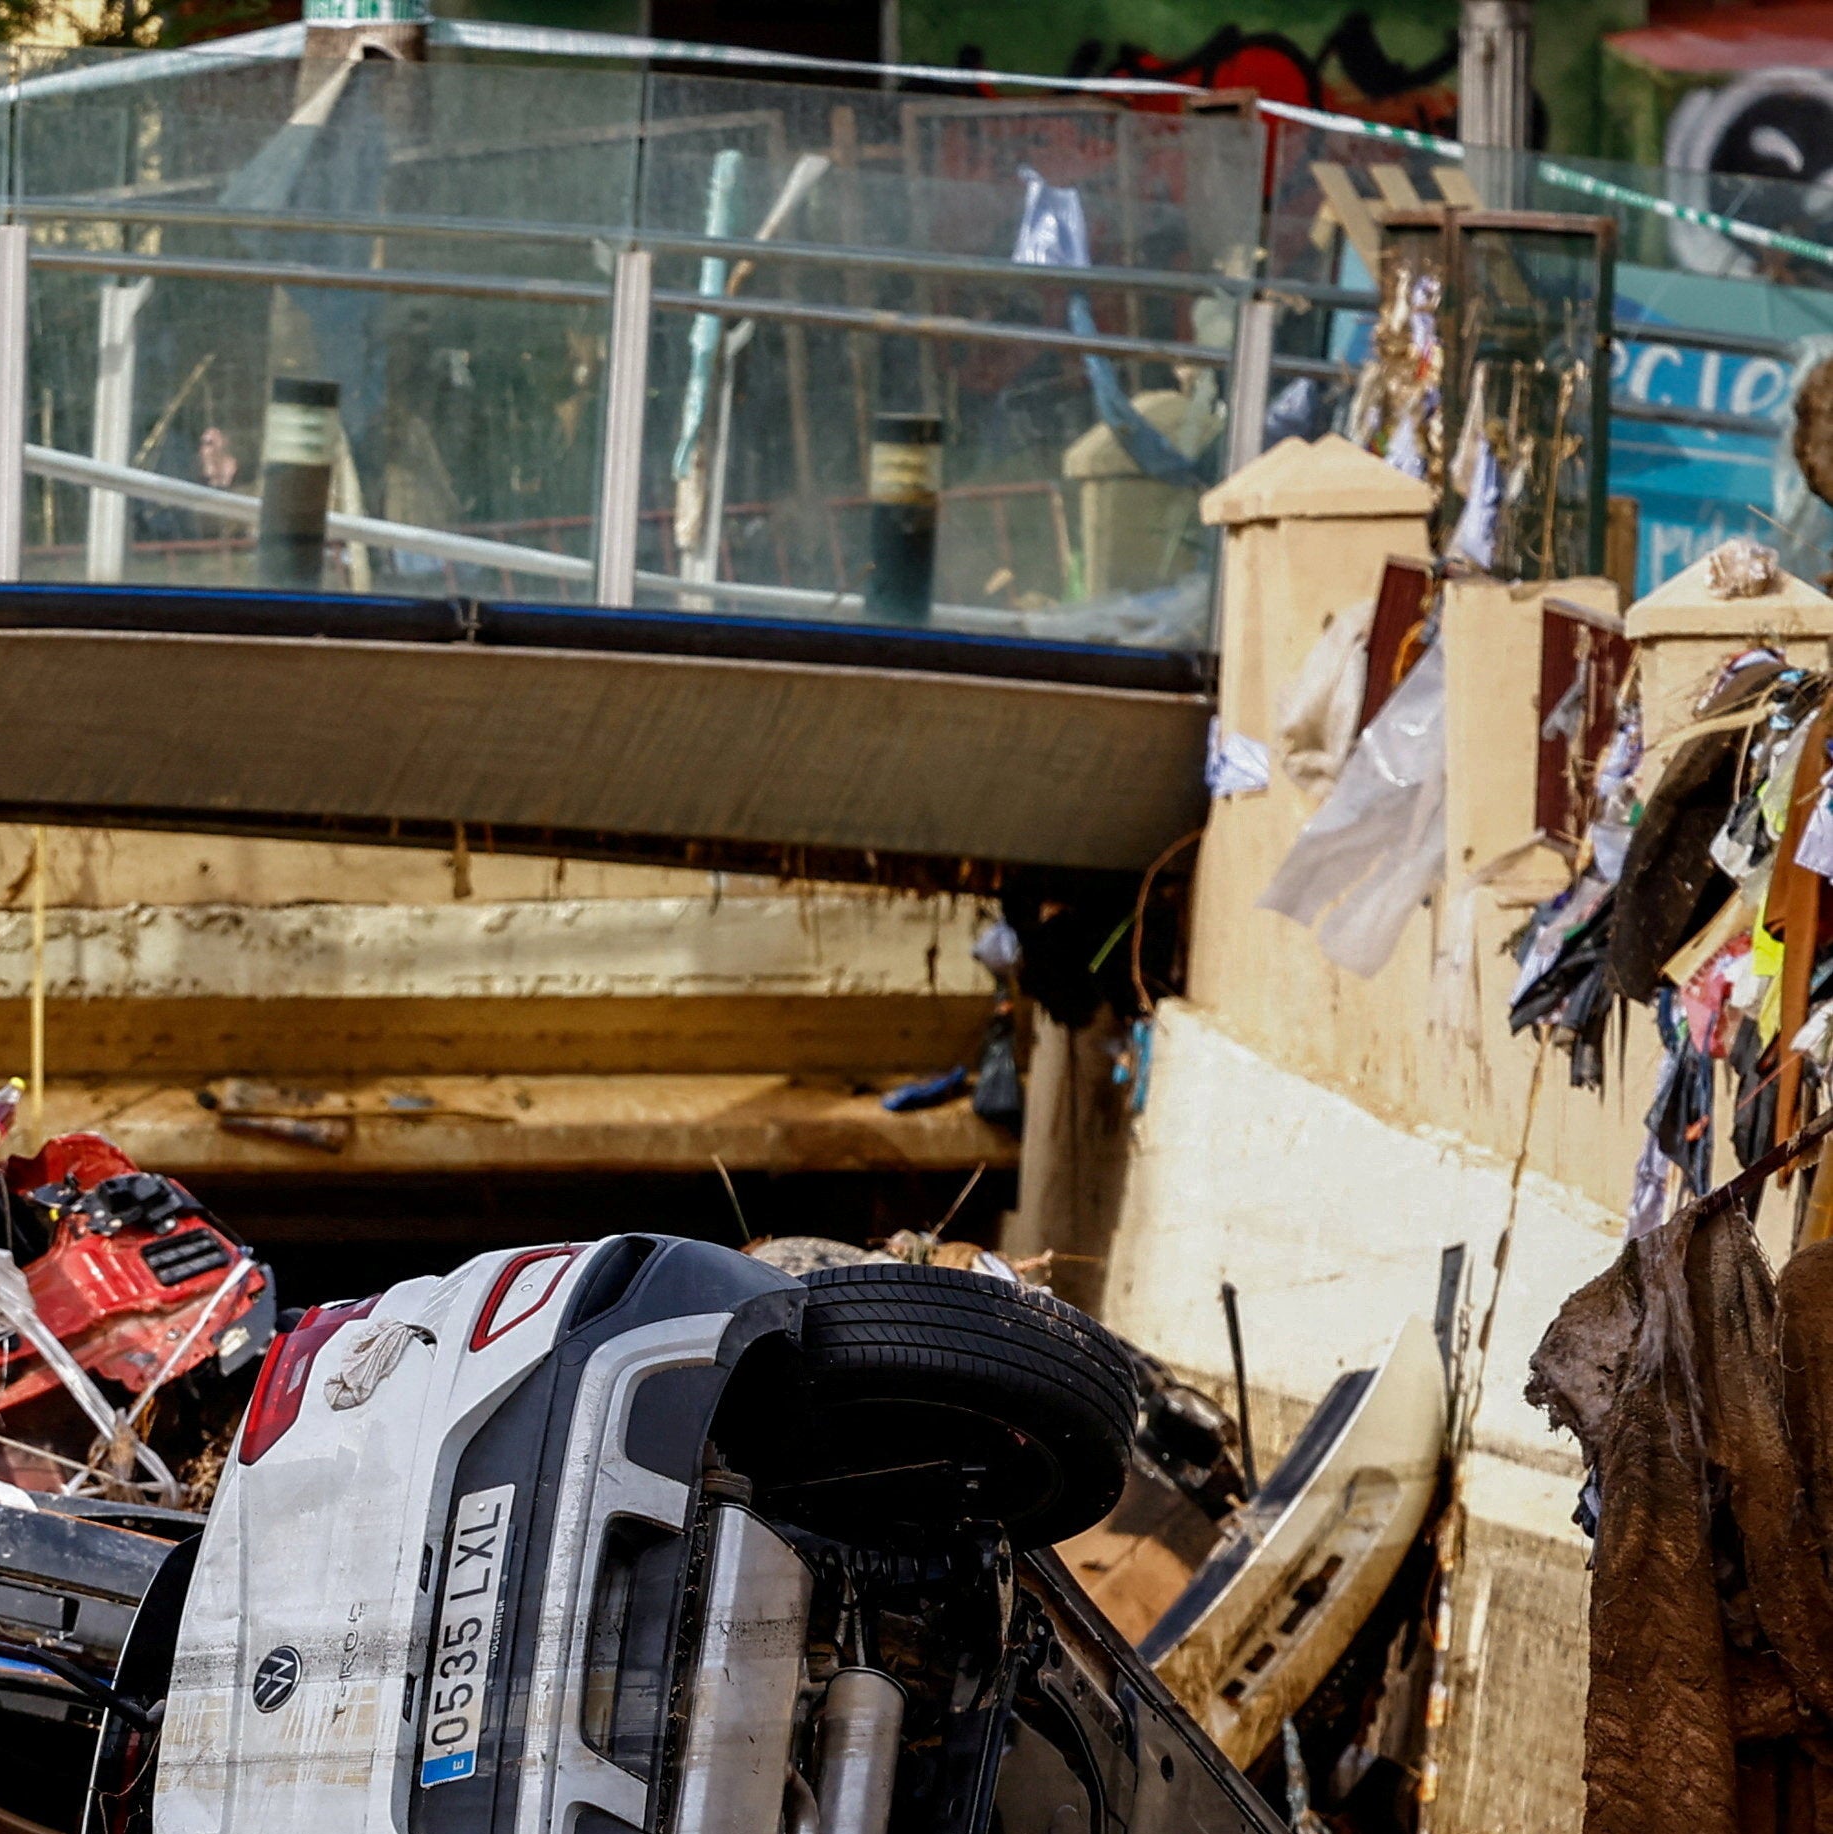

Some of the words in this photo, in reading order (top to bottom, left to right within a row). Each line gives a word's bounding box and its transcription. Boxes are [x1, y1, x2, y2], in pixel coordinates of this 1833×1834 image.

[449, 1502, 502, 1600] LXL
[489, 1599, 506, 1661] VOLCENTER
[431, 1616, 483, 1747] 0535
